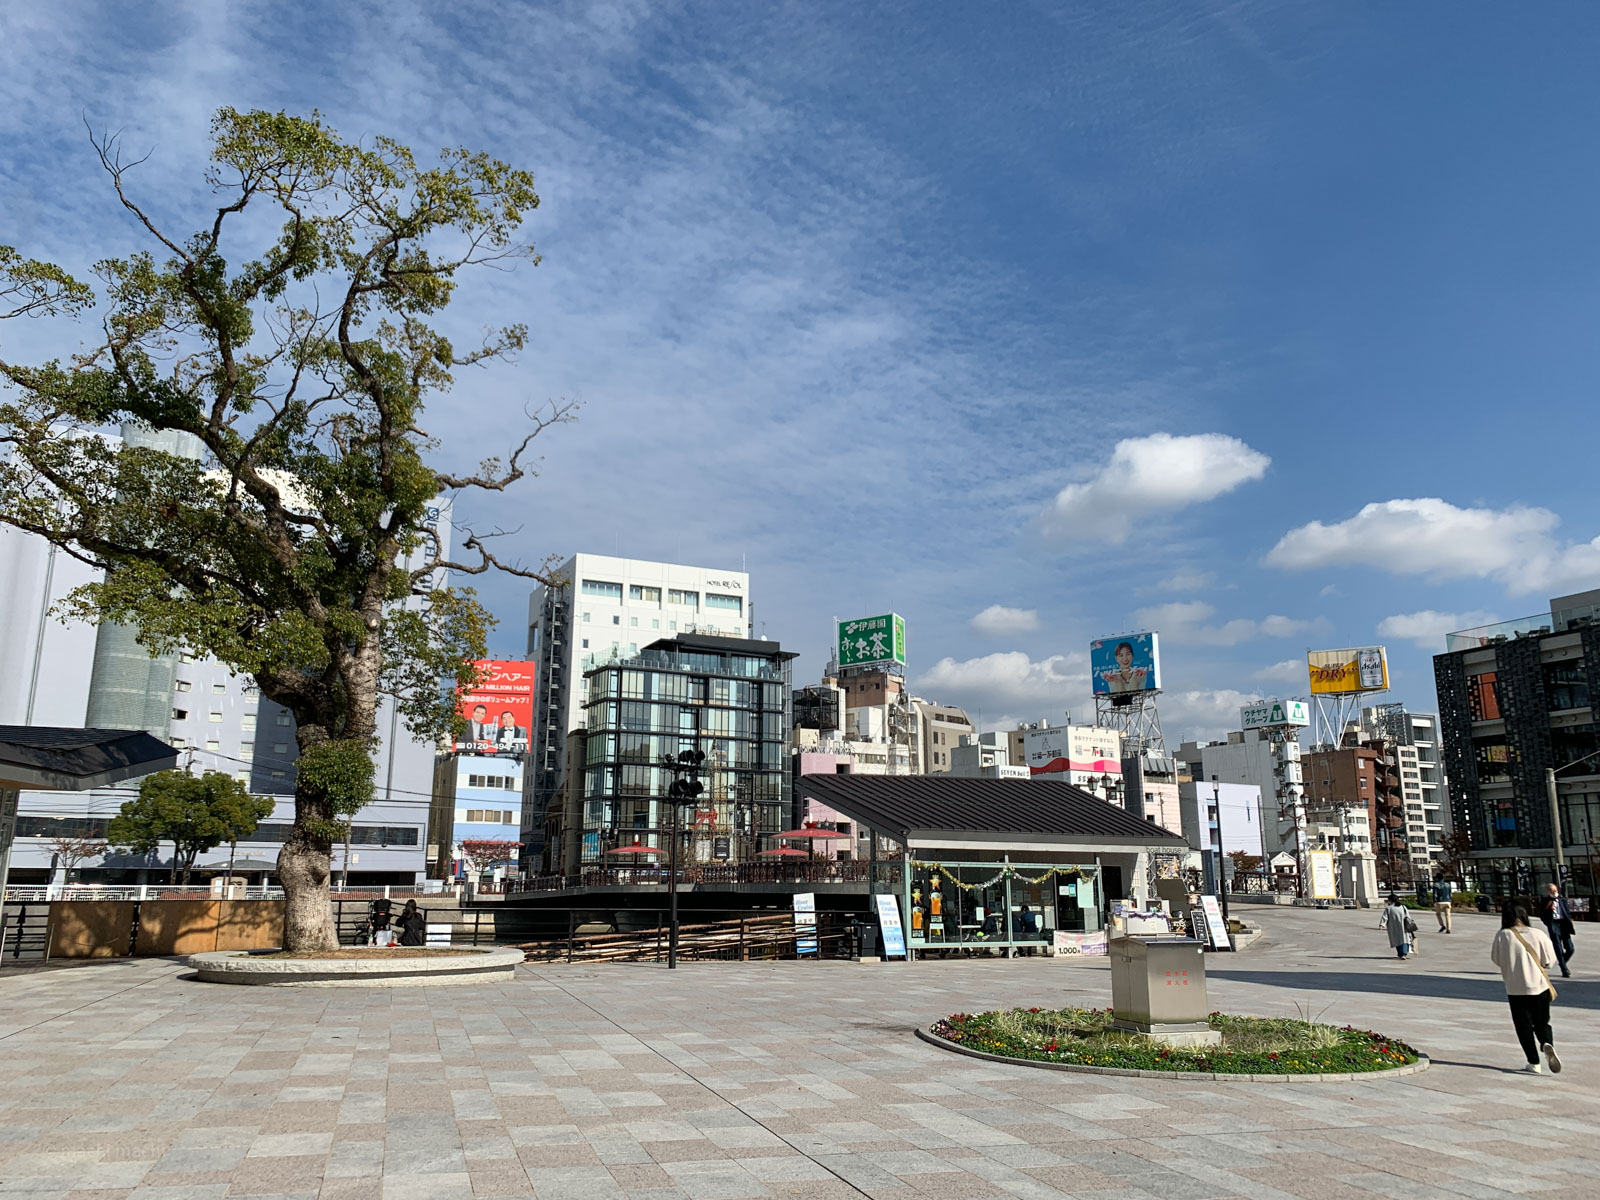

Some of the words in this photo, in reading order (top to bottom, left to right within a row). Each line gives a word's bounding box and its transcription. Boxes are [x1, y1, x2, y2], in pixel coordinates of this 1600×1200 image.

[859, 619, 886, 631] 伊藤園
[1361, 661, 1380, 671] Asahi
[1244, 708, 1268, 718] ウチヤマ
[1245, 715, 1268, 725] グループ
[466, 742, 530, 751] 0120-494-111
[1162, 846, 1182, 854] house
